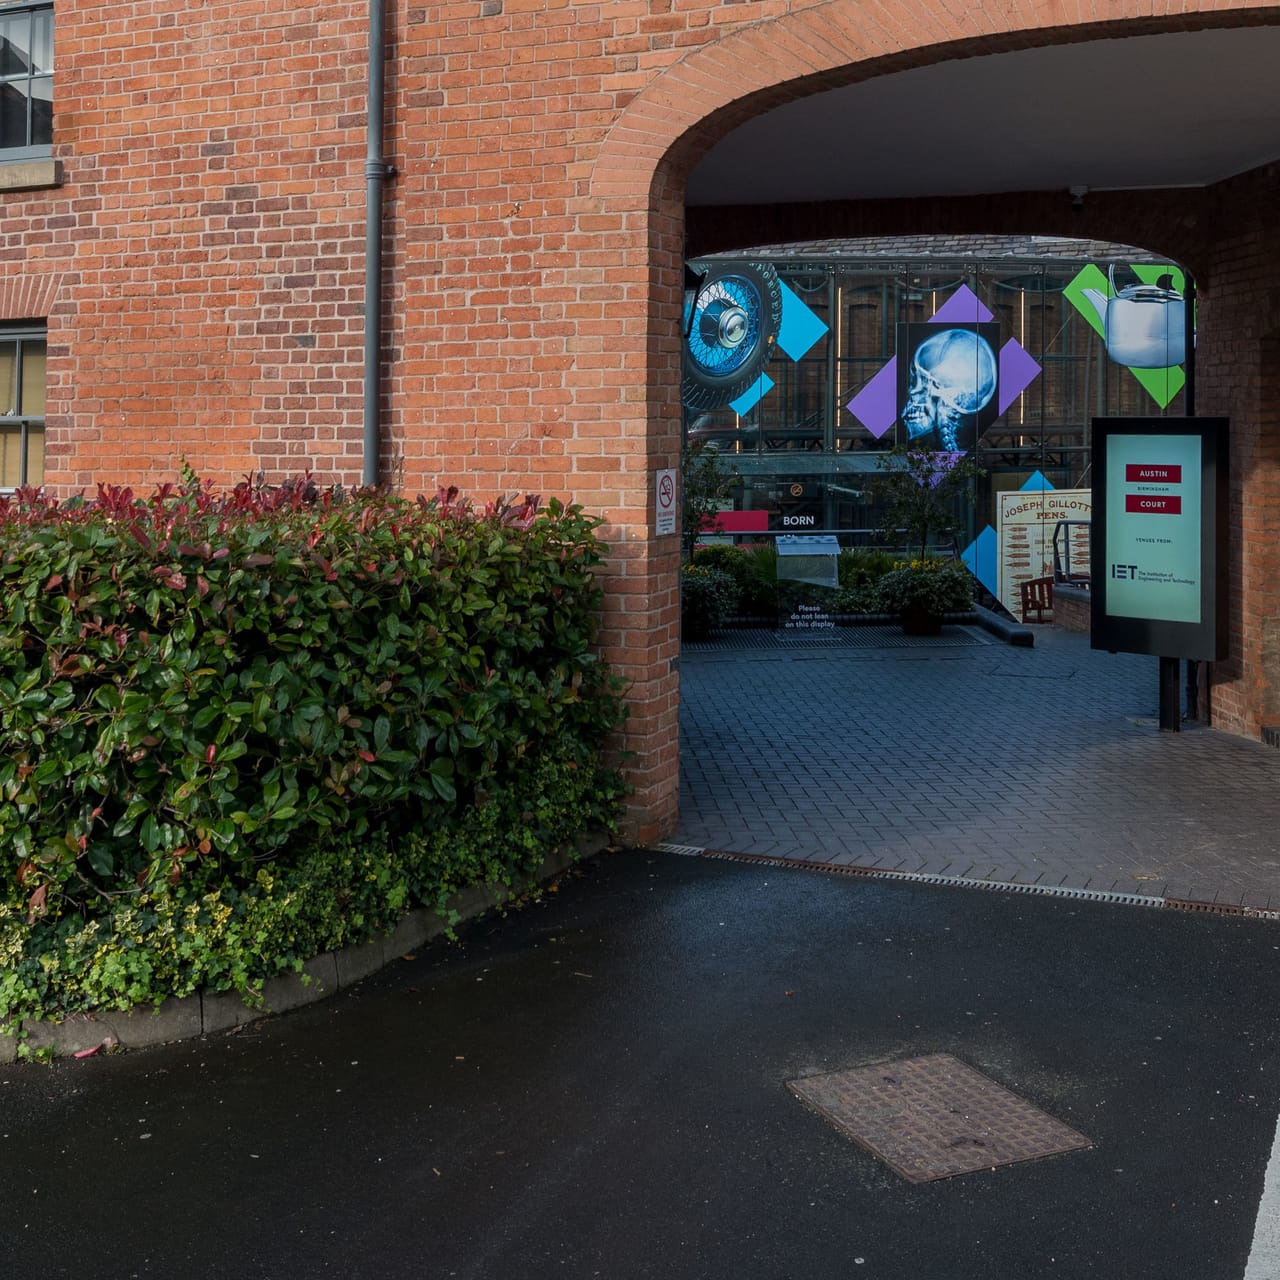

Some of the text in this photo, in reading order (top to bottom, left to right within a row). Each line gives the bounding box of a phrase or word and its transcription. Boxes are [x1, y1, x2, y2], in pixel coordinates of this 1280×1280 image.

[1140, 500, 1166, 508] COURT
[1005, 501, 1043, 518] JOSEPH
[783, 516, 815, 525] BORN
[1112, 564, 1138, 579] IET
[810, 620, 835, 629] display
